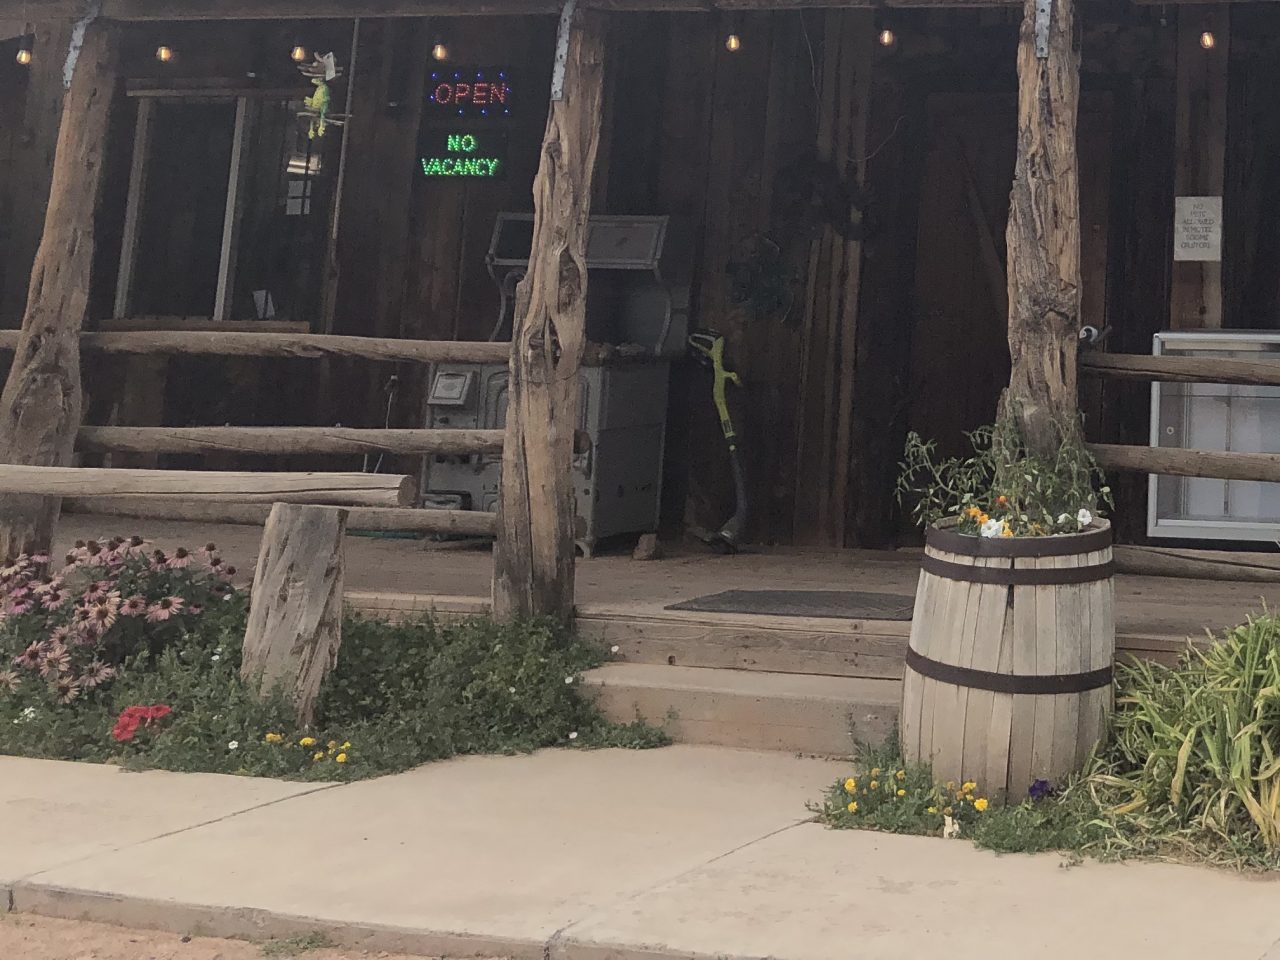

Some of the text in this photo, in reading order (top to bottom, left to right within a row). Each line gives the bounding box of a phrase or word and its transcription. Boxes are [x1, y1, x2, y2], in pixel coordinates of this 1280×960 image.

[435, 83, 506, 104] OPEN
[447, 134, 476, 152] NO
[421, 158, 498, 176] VACANCY
